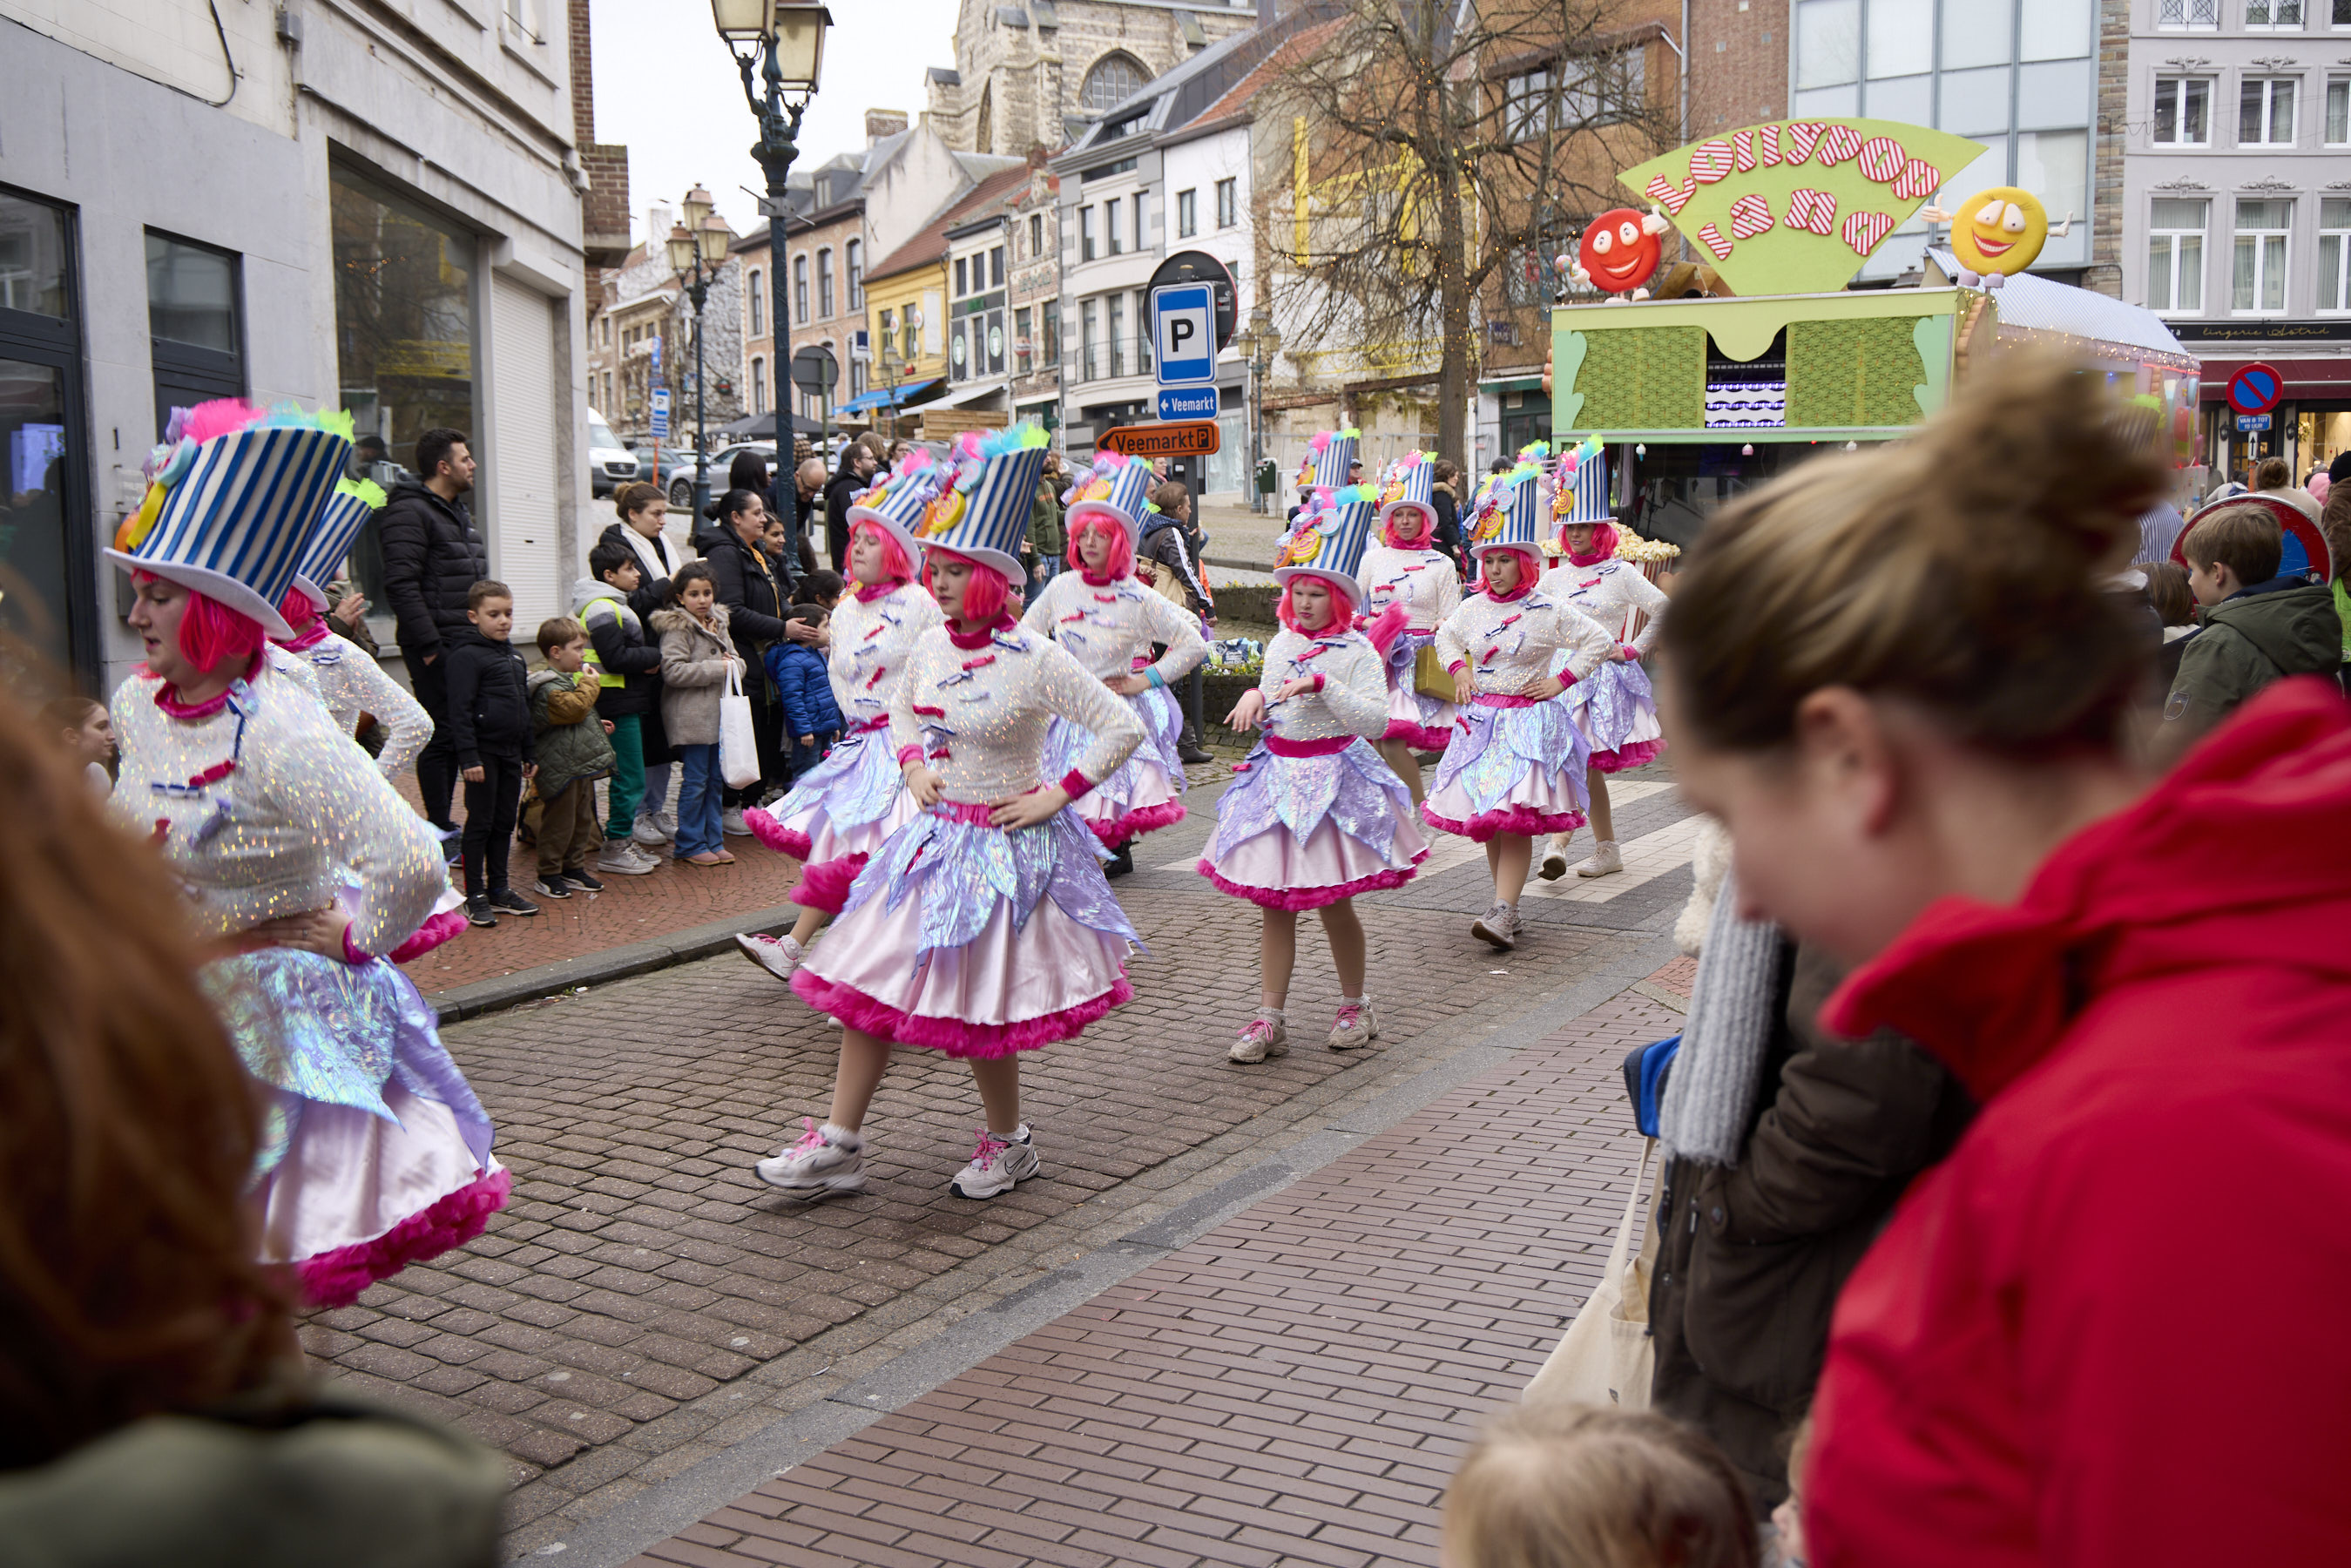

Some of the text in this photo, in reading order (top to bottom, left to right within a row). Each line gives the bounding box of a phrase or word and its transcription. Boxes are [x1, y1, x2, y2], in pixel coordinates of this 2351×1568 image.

[1171, 318, 1194, 352] P
[2203, 327, 2262, 340] lingerie
[1172, 396, 1214, 412] Veemarkt
[1115, 430, 1194, 452] Veemarkt
